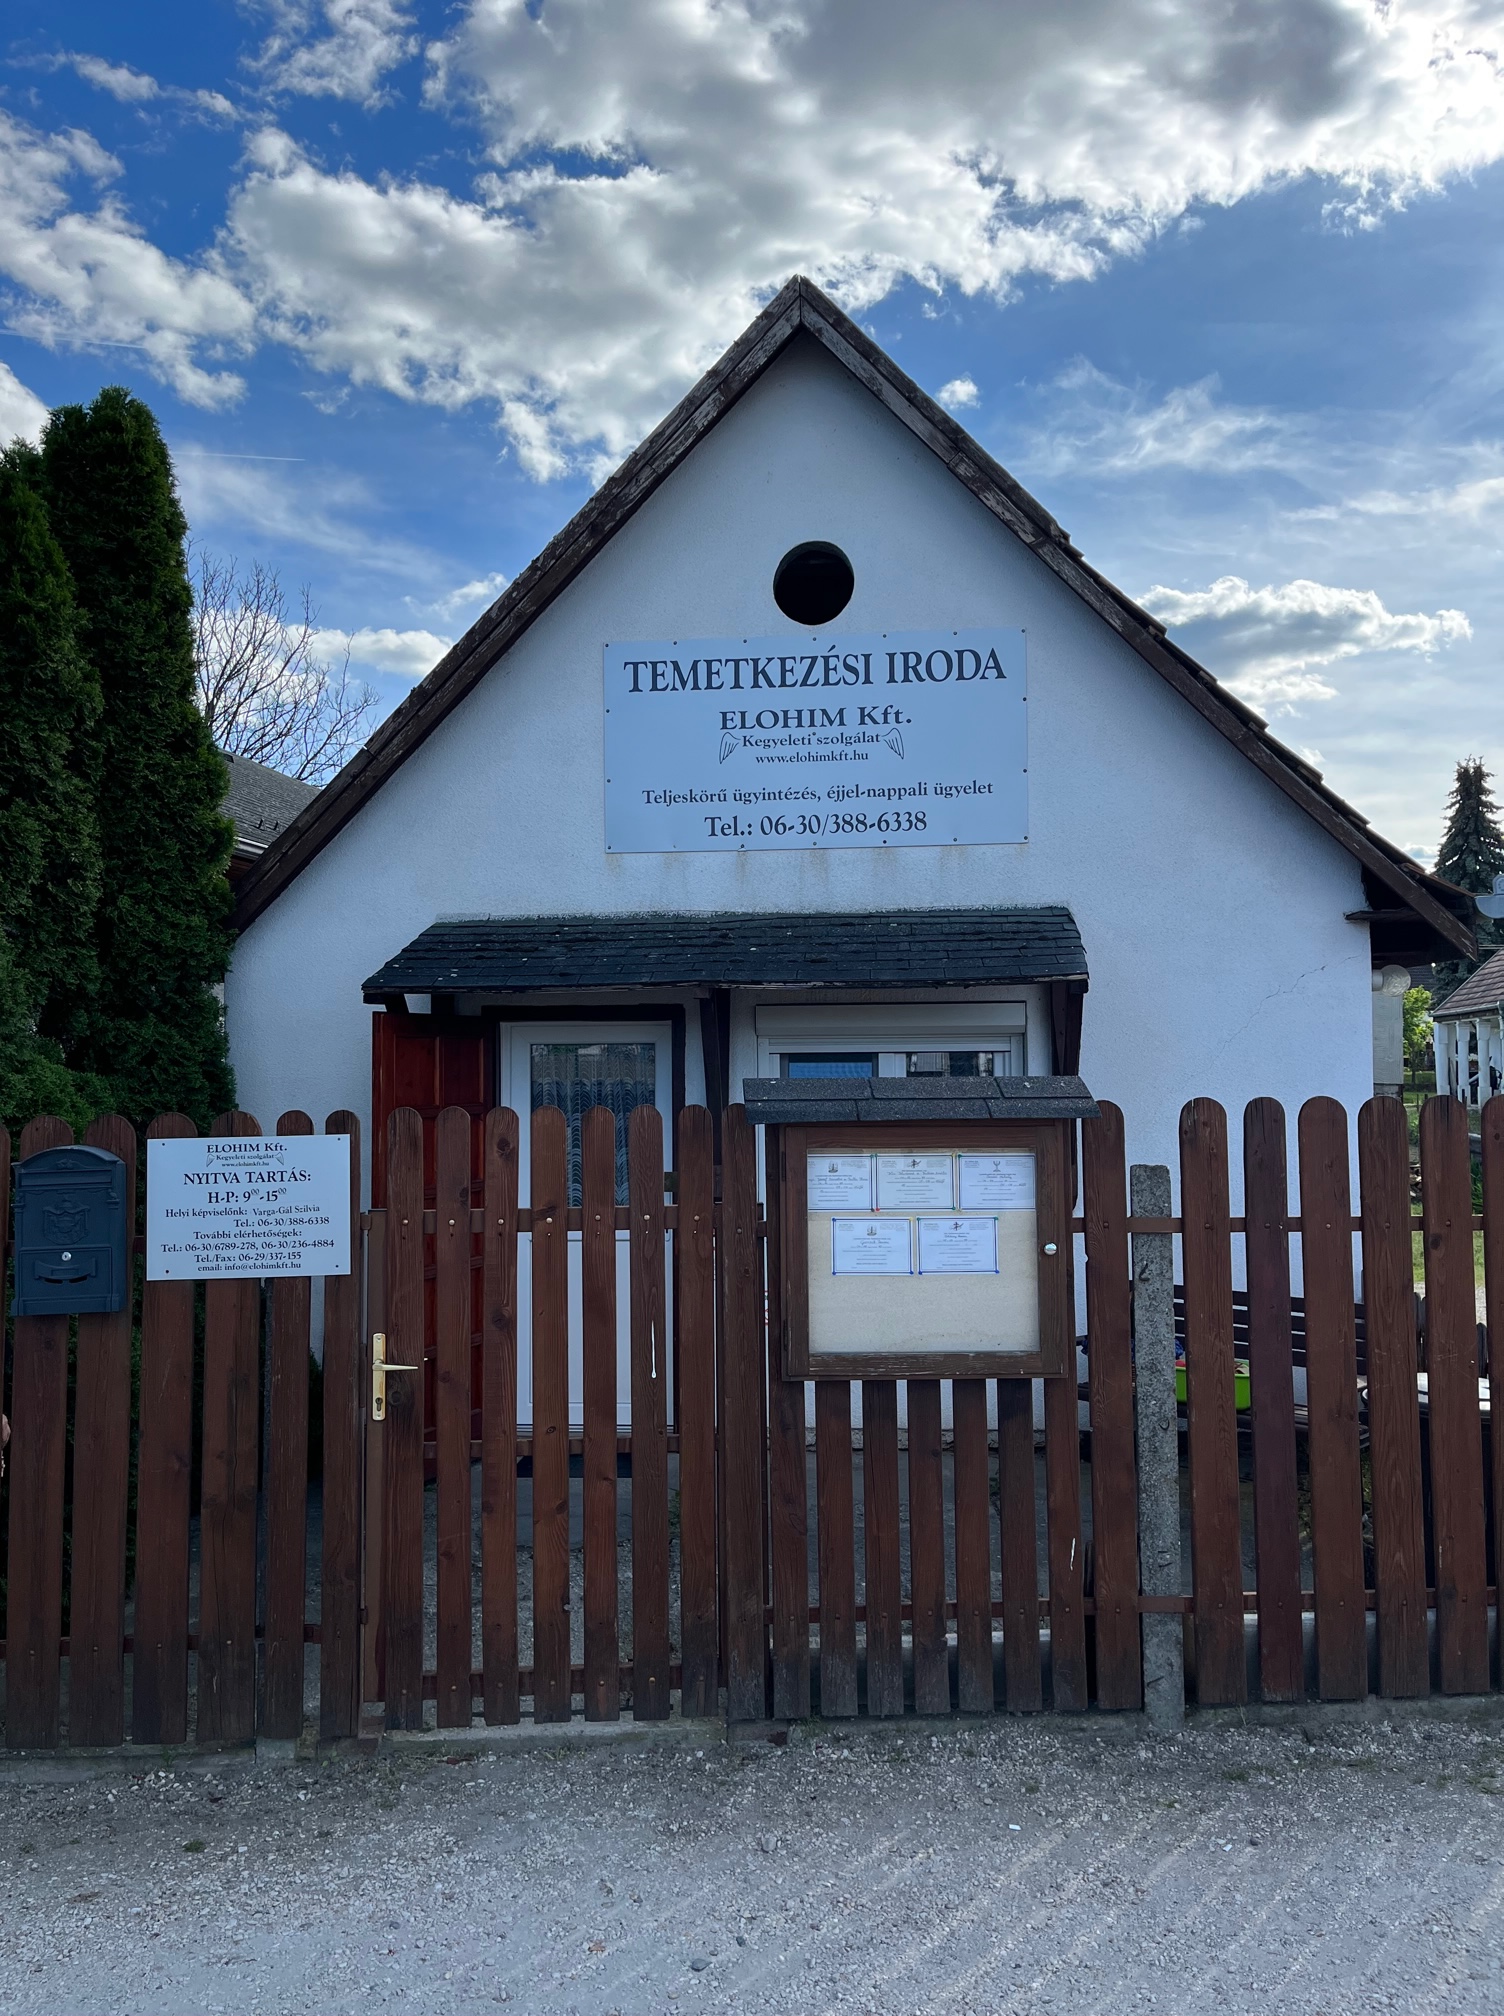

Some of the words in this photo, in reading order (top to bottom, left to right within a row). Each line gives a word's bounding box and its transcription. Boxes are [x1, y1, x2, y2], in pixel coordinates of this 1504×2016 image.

[624, 645, 873, 693] TEMETKEZÉSI
[886, 647, 1007, 684] IRODA
[719, 707, 847, 730] ELOHIM
[858, 705, 912, 726] Kft.
[742, 733, 812, 749] Kegyeleti
[816, 732, 881, 747] szolgálat
[755, 749, 869, 763] www.elohimkft.hu
[642, 789, 727, 807] Teljeskörű
[733, 786, 821, 805] ügyintézés,
[827, 782, 928, 801] éjjel-nappali
[933, 781, 993, 797] ügyelet
[705, 816, 752, 837] Tel.:
[760, 811, 927, 836] 06-30/388-6338
[207, 1144, 259, 1153] ELOHIM
[264, 1143, 287, 1152] Kft.
[184, 1172, 240, 1185] NYITVA
[245, 1167, 312, 1183] TARTÁS:
[208, 1192, 239, 1203] H-P:
[165, 1209, 190, 1218] Helyi
[192, 1208, 248, 1218] képviselőnk:
[253, 1206, 292, 1216] Varga-Gál
[295, 1205, 320, 1214] Szilvia
[234, 1219, 255, 1227] Tel.:
[258, 1217, 330, 1226] 06-30/388-6338
[193, 1231, 231, 1239] További
[234, 1229, 302, 1238] elérhetőségek:
[161, 1244, 182, 1252] Tel.:
[185, 1241, 259, 1252] 06-30/6789-278,
[261, 1239, 334, 1249] 06-30/236-4884
[194, 1255, 236, 1263] Tel./Fax:
[238, 1252, 301, 1262] 06-29/337-155
[224, 1262, 301, 1271] info@elohimkft.hu
